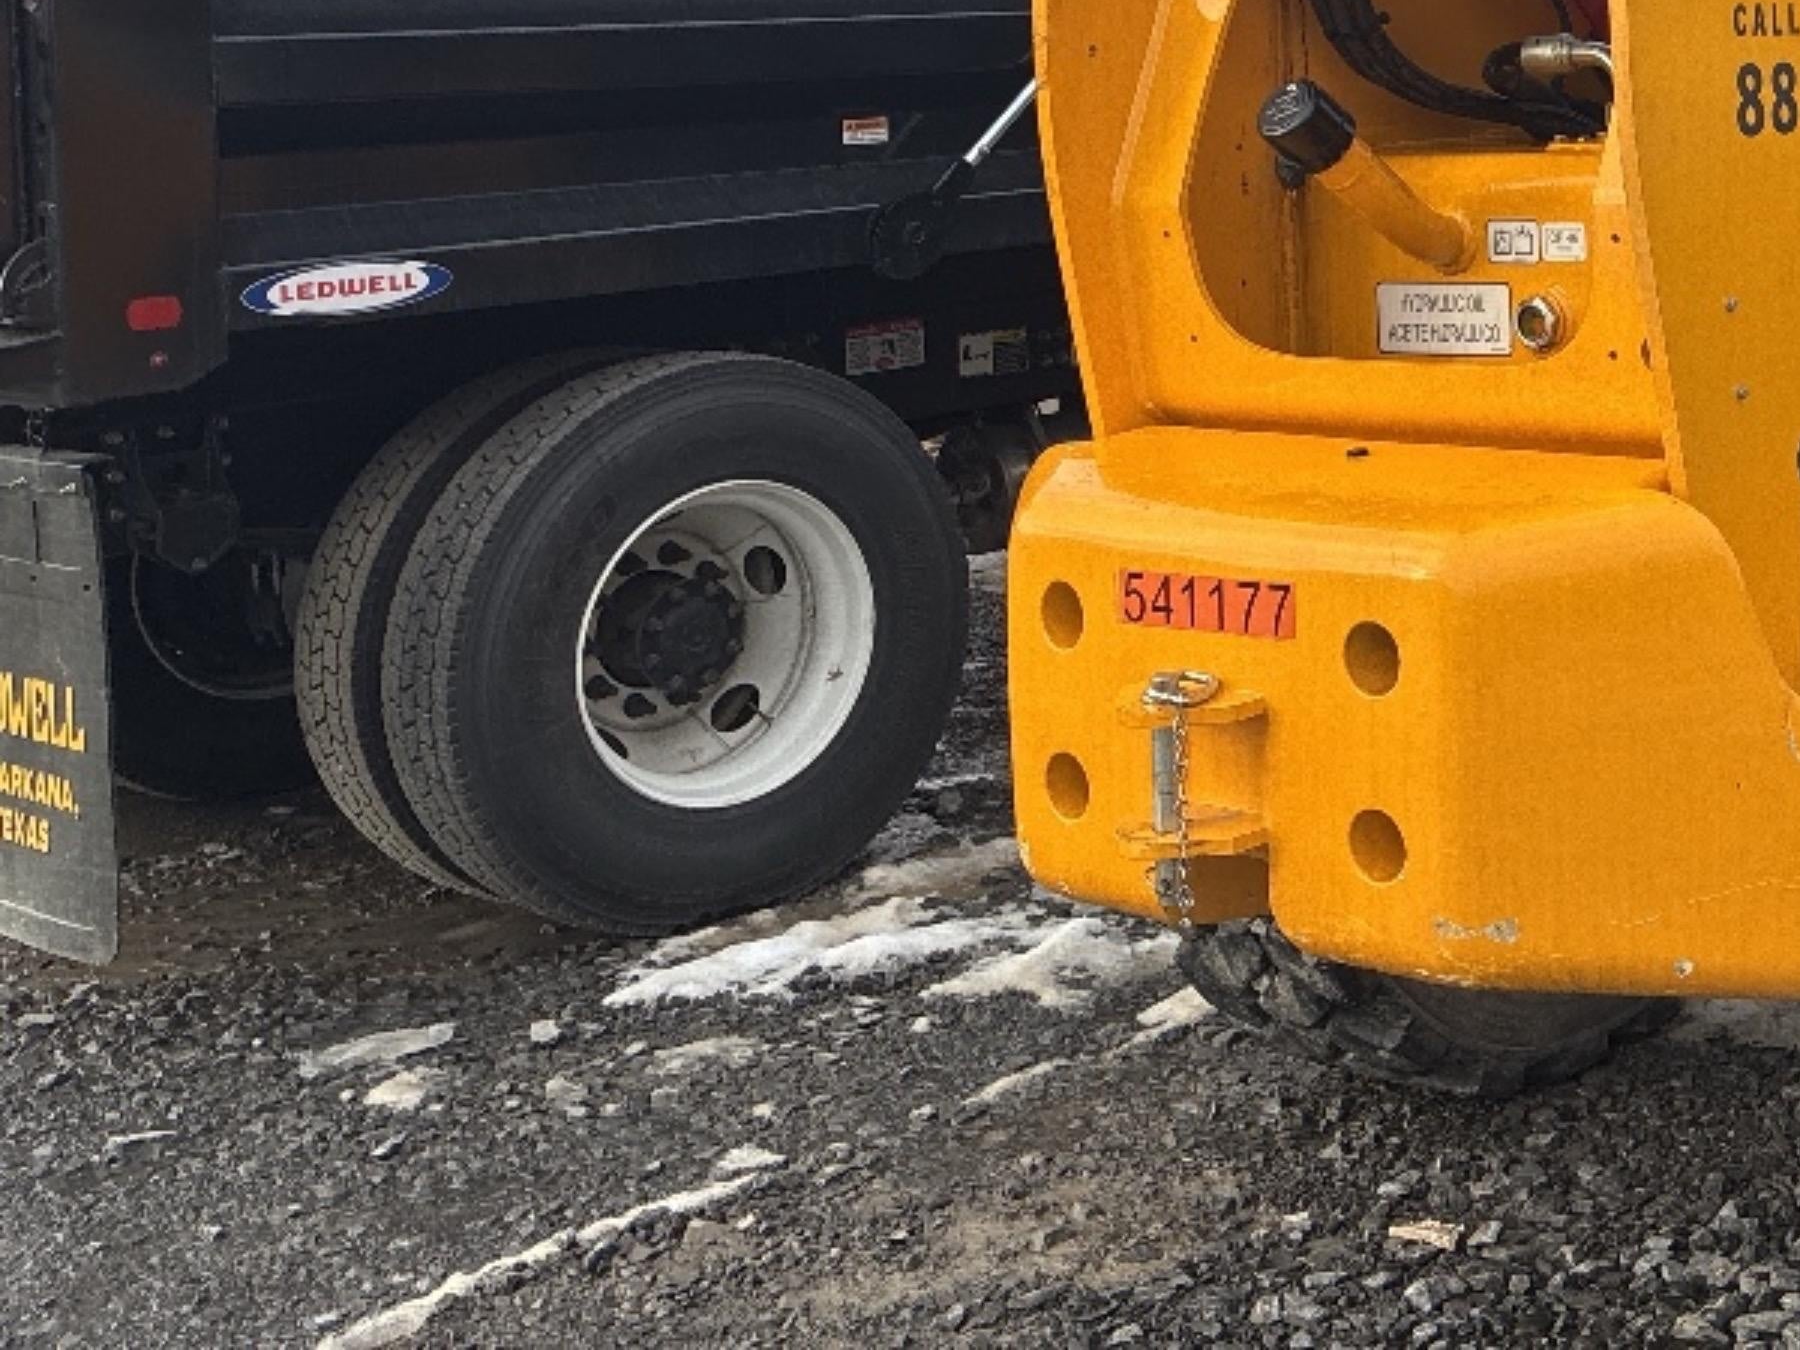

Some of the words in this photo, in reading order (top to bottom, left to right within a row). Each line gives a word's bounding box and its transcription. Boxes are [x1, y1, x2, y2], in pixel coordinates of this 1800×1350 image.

[1733, 2, 1800, 37] CALL
[278, 272, 418, 303] LEDWELL
[1124, 572, 1291, 637] 541177
